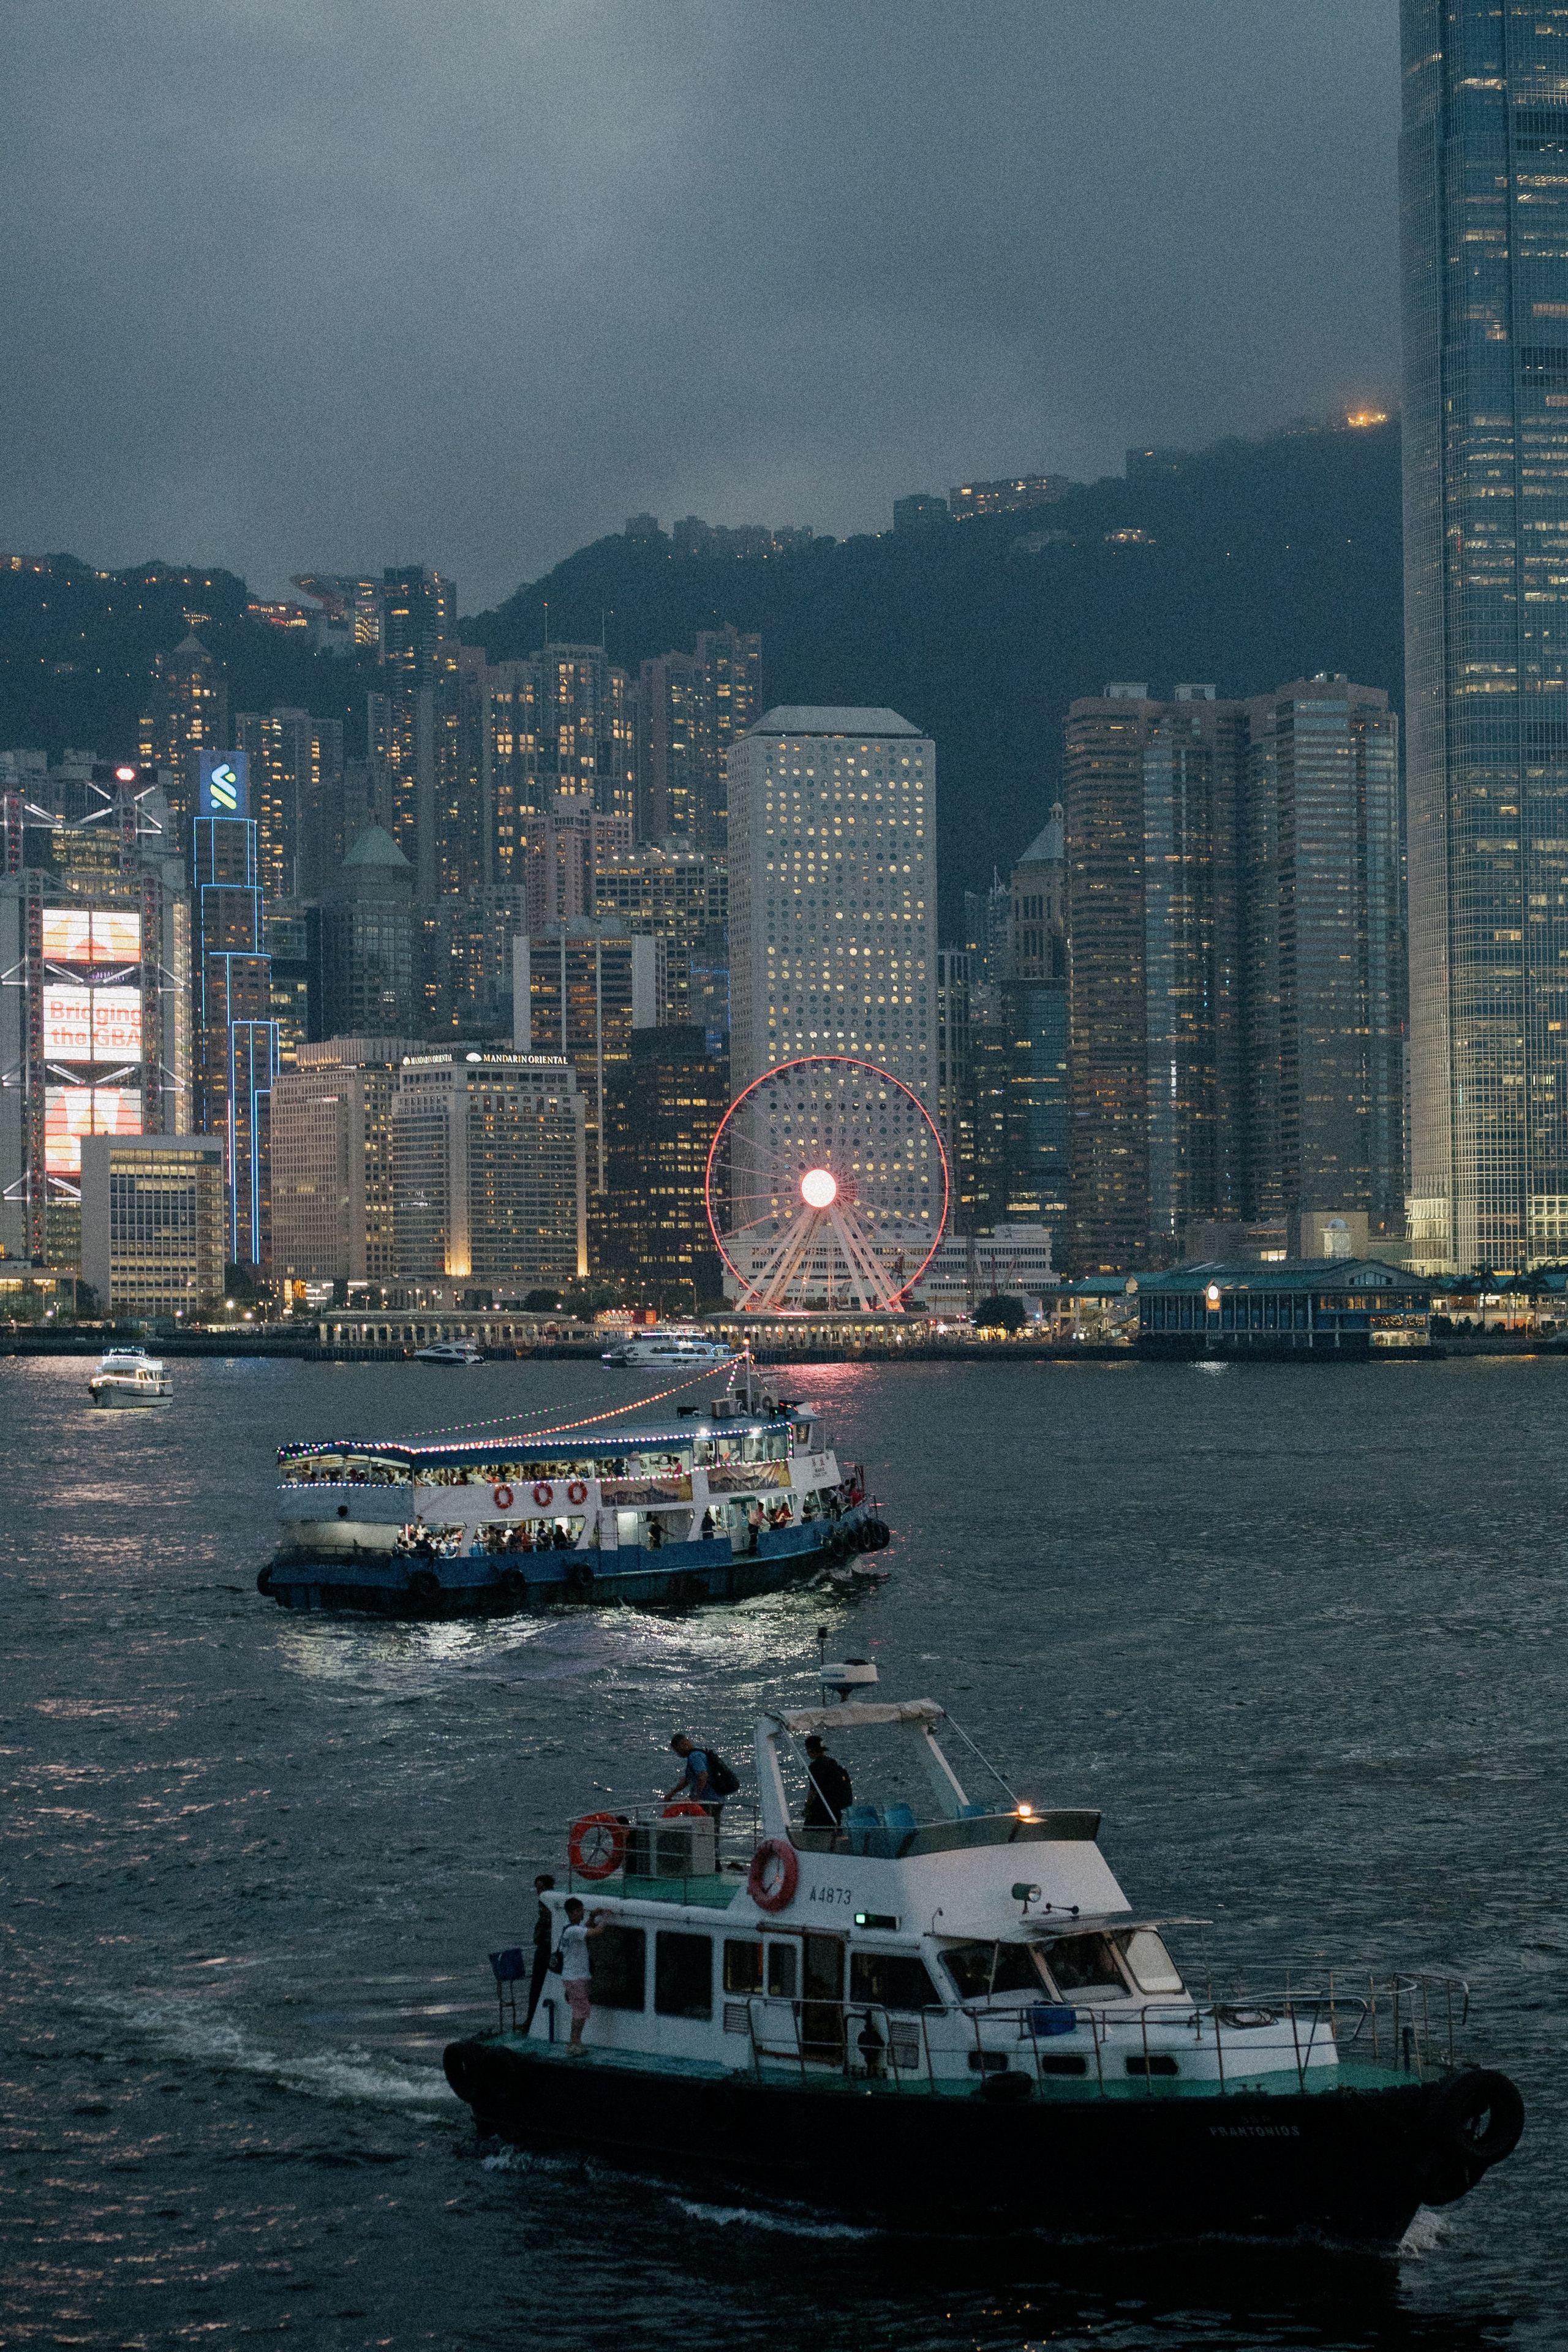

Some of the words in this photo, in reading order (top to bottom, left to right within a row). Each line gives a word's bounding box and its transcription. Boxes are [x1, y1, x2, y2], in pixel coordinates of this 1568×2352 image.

[51, 1001, 141, 1027] Bridging
[51, 1027, 87, 1045] the
[93, 1028, 141, 1047] GBA
[410, 1055, 432, 1065] MANDARIN
[432, 1054, 453, 1063] ORIENTAL
[483, 1054, 527, 1063] MANDARIN
[528, 1055, 568, 1065] ORIENTAL
[809, 1887, 851, 1905] A4873
